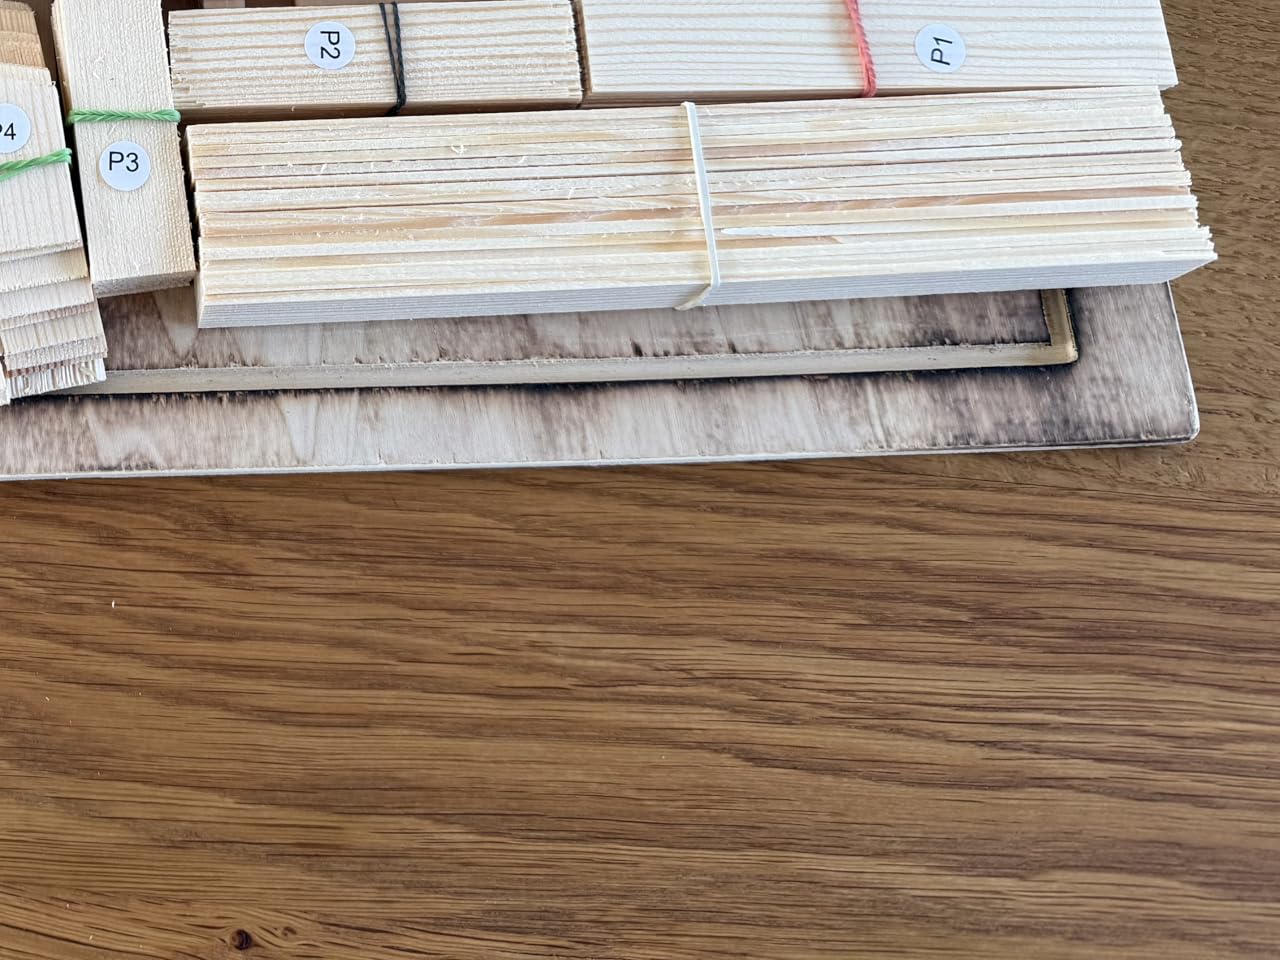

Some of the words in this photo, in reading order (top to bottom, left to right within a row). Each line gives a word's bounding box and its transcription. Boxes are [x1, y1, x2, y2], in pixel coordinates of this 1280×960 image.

[319, 30, 341, 60] P2
[930, 36, 953, 66] P1
[109, 151, 139, 173] P3
